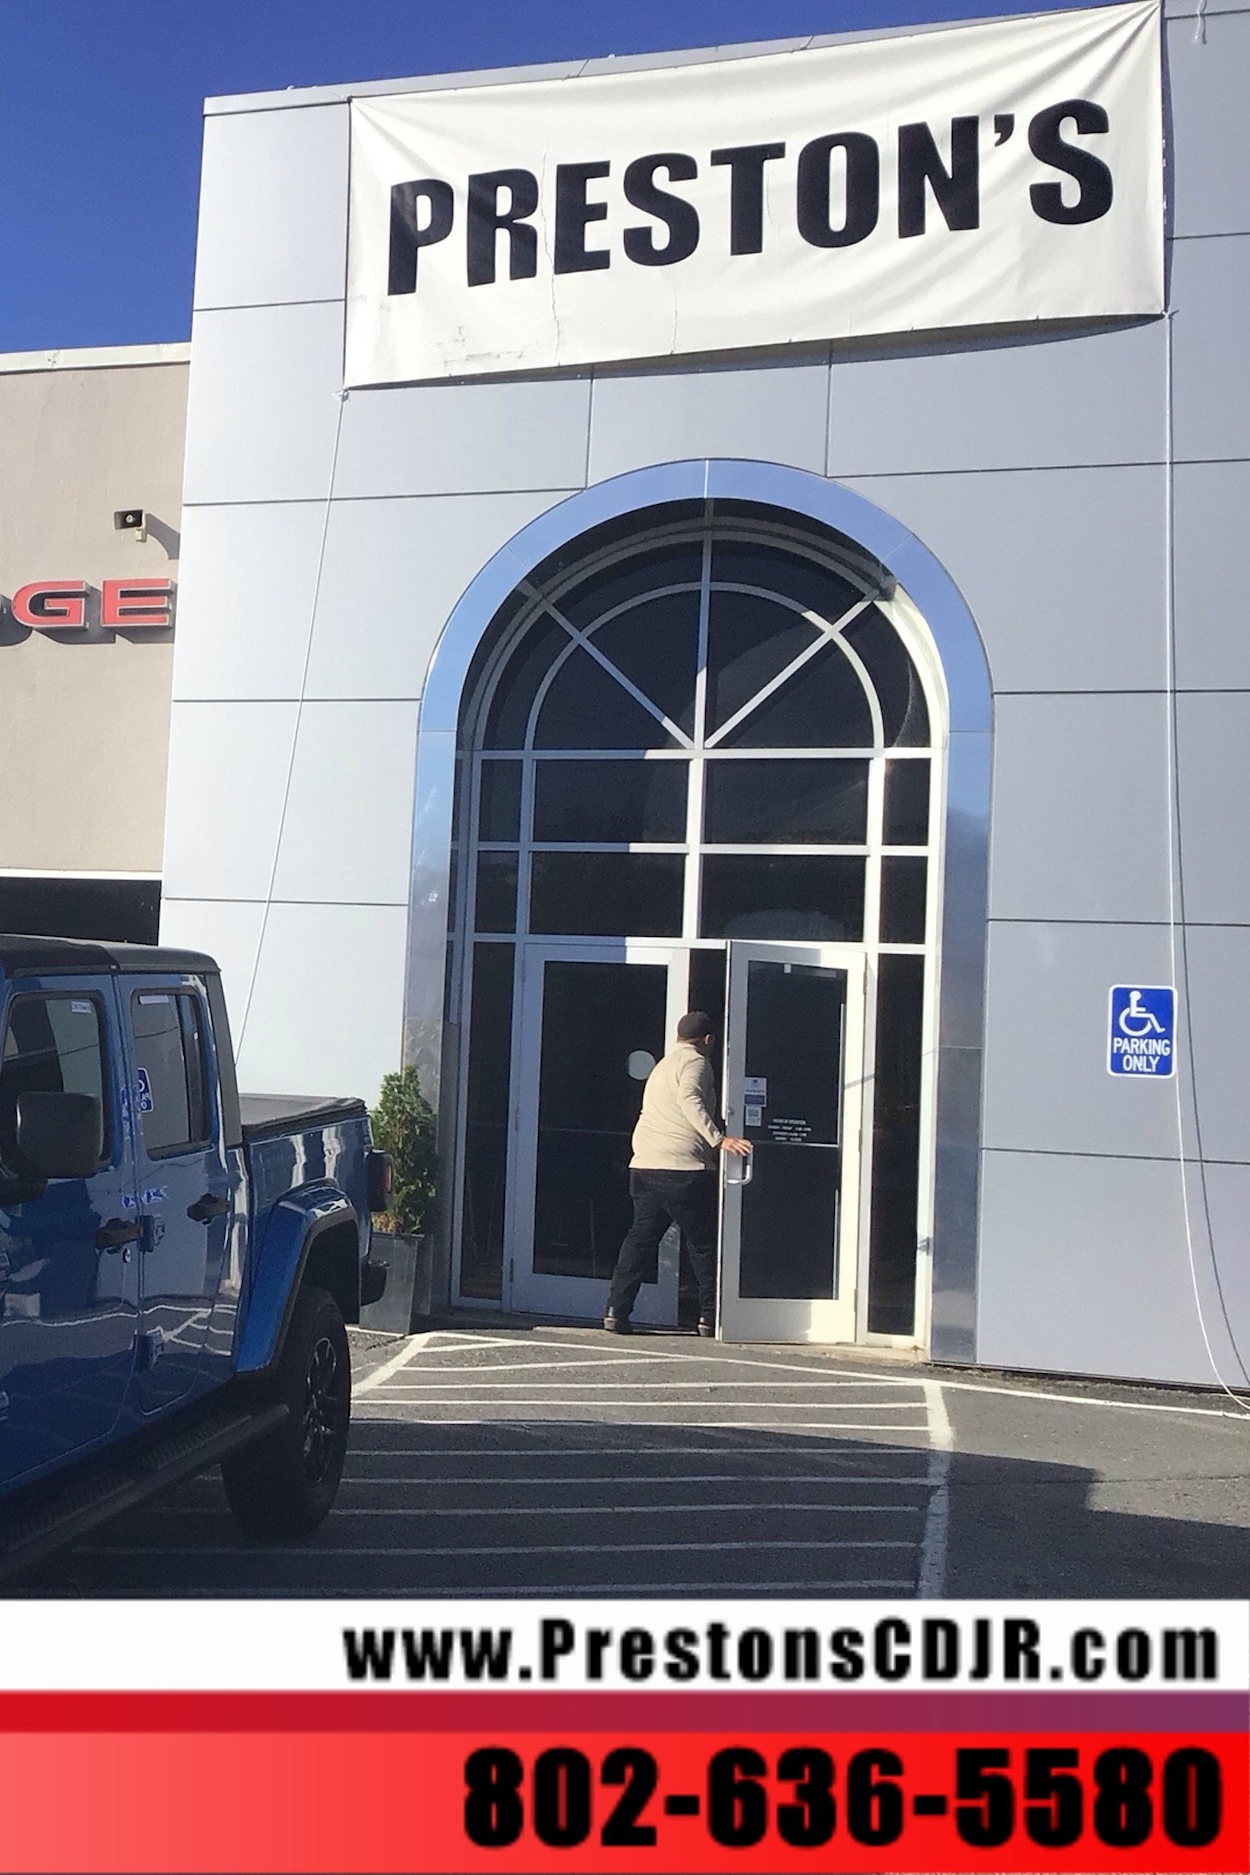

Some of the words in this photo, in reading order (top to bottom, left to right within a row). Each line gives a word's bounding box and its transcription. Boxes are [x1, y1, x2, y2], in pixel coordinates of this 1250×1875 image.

[387, 98, 1113, 296] PRESTON'S
[1113, 1037, 1171, 1056] PARKING
[1122, 1055, 1160, 1072] ONLY
